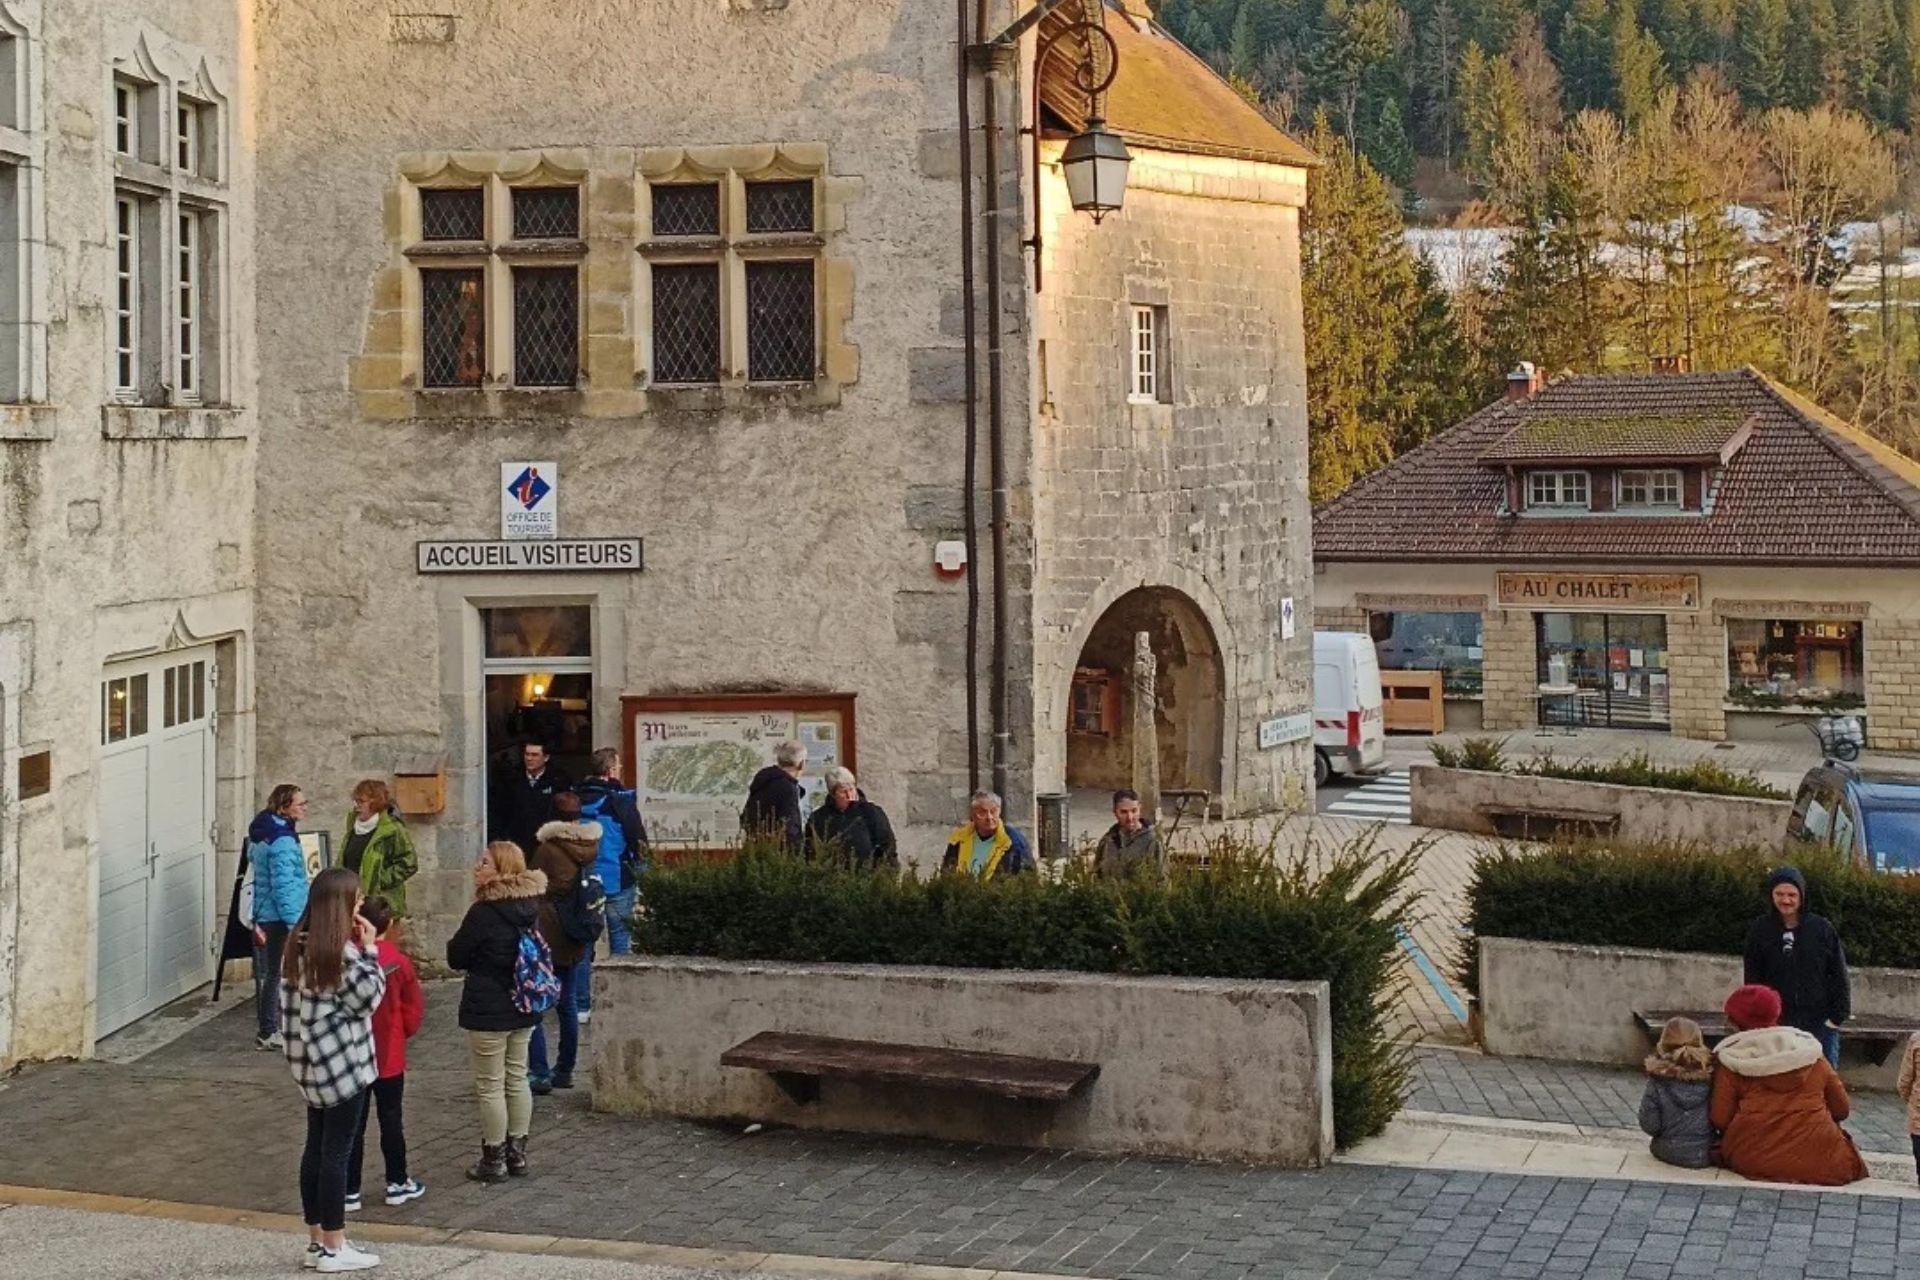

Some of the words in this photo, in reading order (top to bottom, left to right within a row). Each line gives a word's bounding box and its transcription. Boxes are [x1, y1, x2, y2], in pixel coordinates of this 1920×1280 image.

[506, 512, 538, 522] OFFICE
[540, 512, 552, 522] DE
[508, 524, 552, 533] TOURISME
[426, 545, 518, 567] ACCUEIL
[522, 544, 632, 565] VISITEURS
[1522, 579, 1548, 597] AU
[1556, 581, 1633, 599] CHALET
